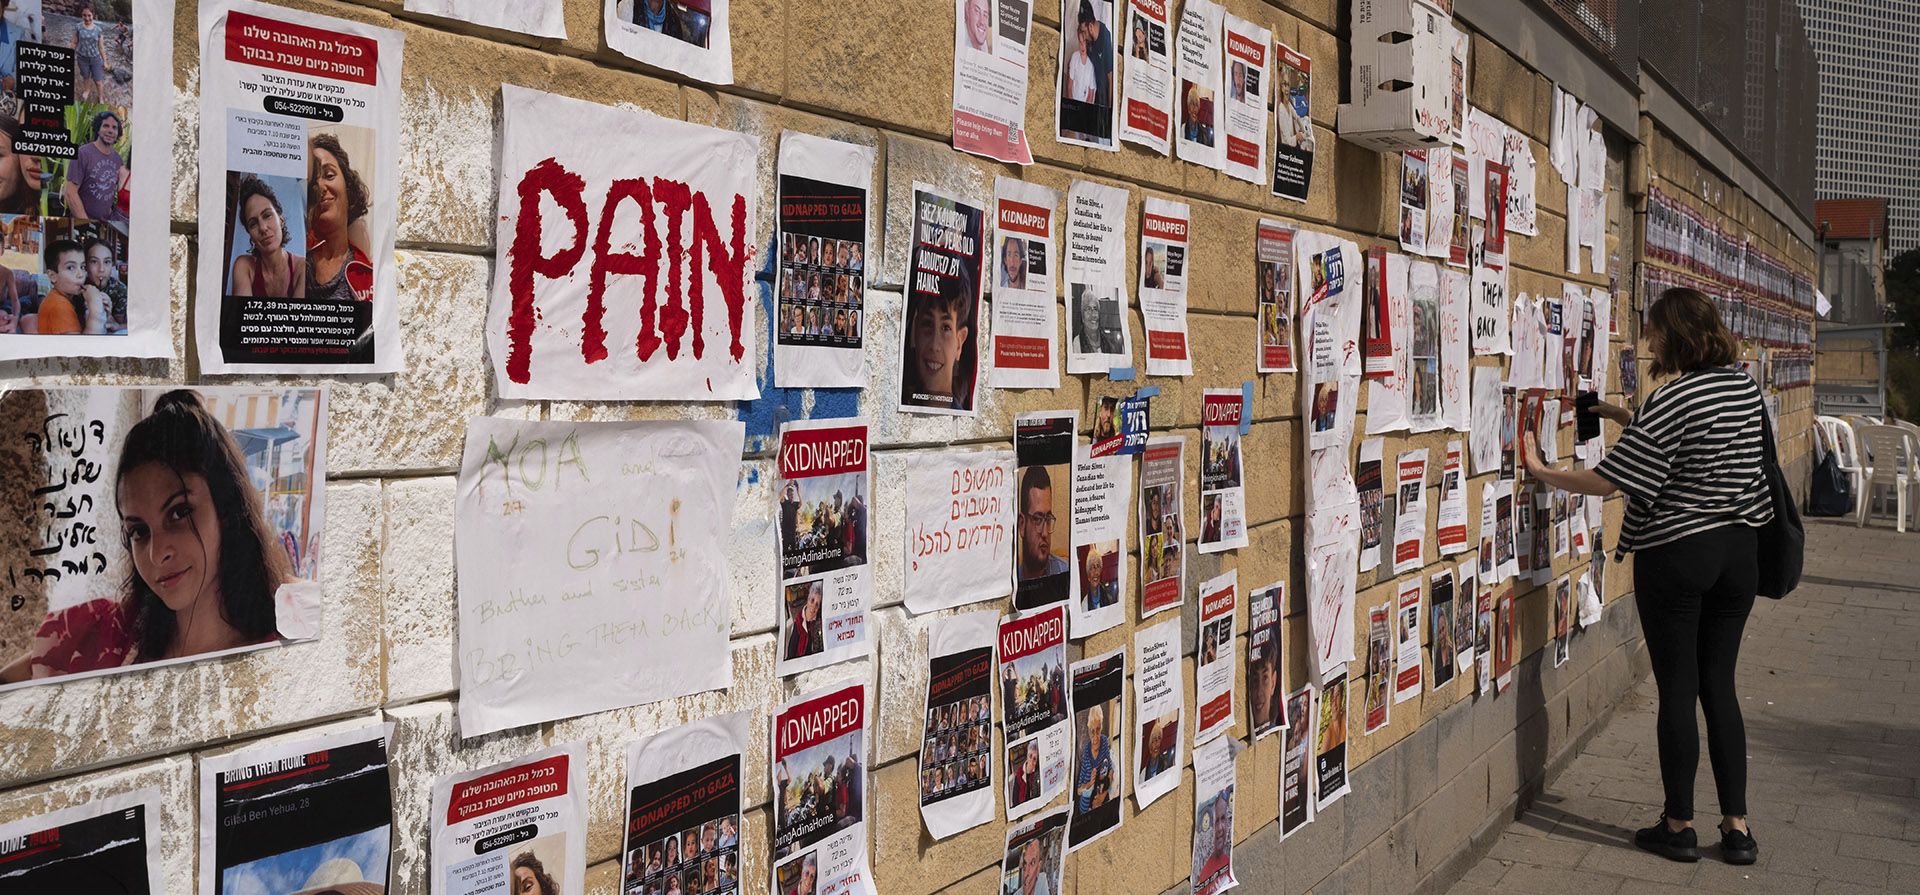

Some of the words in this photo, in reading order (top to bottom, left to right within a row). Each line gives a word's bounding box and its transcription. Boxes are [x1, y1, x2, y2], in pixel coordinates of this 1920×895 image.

[243, 25, 271, 39] שלנו
[273, 32, 317, 50] האהובה
[319, 40, 333, 53] גת
[20, 47, 47, 59] קלדרון
[48, 51, 65, 60] עפר
[239, 45, 275, 62] בבוקר
[335, 41, 363, 58] כרמל
[277, 53, 304, 67] שבת
[306, 58, 329, 71] מיום
[19, 61, 47, 73] קלדרון
[48, 65, 65, 73] סהר
[331, 63, 365, 77] חטופה
[20, 74, 48, 87] קלדרון
[49, 78, 64, 87] ארז
[261, 73, 286, 85] הציבור
[286, 78, 305, 88] עזרת
[239, 80, 258, 93] קשר!
[259, 84, 278, 95] ליצור
[278, 87, 296, 98] עליה
[306, 82, 317, 90] את
[318, 84, 346, 95] מבקשים
[24, 89, 32, 98] דן
[34, 90, 61, 101] כרמלה
[296, 91, 313, 100] שמע
[314, 93, 322, 102] או
[322, 95, 343, 105] שראה
[30, 103, 39, 113] דן
[274, 101, 317, 115] 054-5229901
[343, 98, 352, 106] מי
[351, 98, 366, 109] מכל
[323, 108, 334, 118] גיל
[22, 130, 40, 140] קשר
[41, 132, 68, 141] ליצירת
[14, 141, 76, 156] 0547917020
[829, 203, 840, 215] TO
[1001, 208, 1046, 231] KIDNAPPED
[506, 156, 747, 384] PAIN
[949, 258, 960, 277] BY
[260, 325, 272, 333] עם
[1476, 316, 1496, 339] BACK
[783, 438, 864, 473] KIDNAPPED
[468, 428, 590, 505] NOA
[621, 445, 658, 477] and
[957, 518, 1004, 561] קודמים
[1003, 617, 1061, 658] KIDNAPPED
[224, 766, 252, 784] BRING
[255, 760, 280, 777] THEM
[281, 754, 306, 772] HOME
[307, 750, 329, 766] NOW
[531, 767, 555, 779] כרמל
[483, 775, 516, 792] האהובה
[517, 773, 529, 782] גת
[462, 785, 482, 799] שלנו
[506, 789, 525, 802] מיום
[527, 782, 558, 796] חטופה
[485, 794, 505, 808] שבת
[629, 794, 691, 833] KIDNAPPED
[691, 786, 706, 802] TO
[707, 772, 735, 795] GAZA
[224, 813, 247, 827] Gilad
[249, 810, 267, 821] Ben
[269, 802, 298, 816] Yehua,
[299, 797, 310, 809] 28
[458, 801, 483, 817] בבוקר
[515, 805, 540, 817] מבקשים
[0, 835, 27, 855] OME
